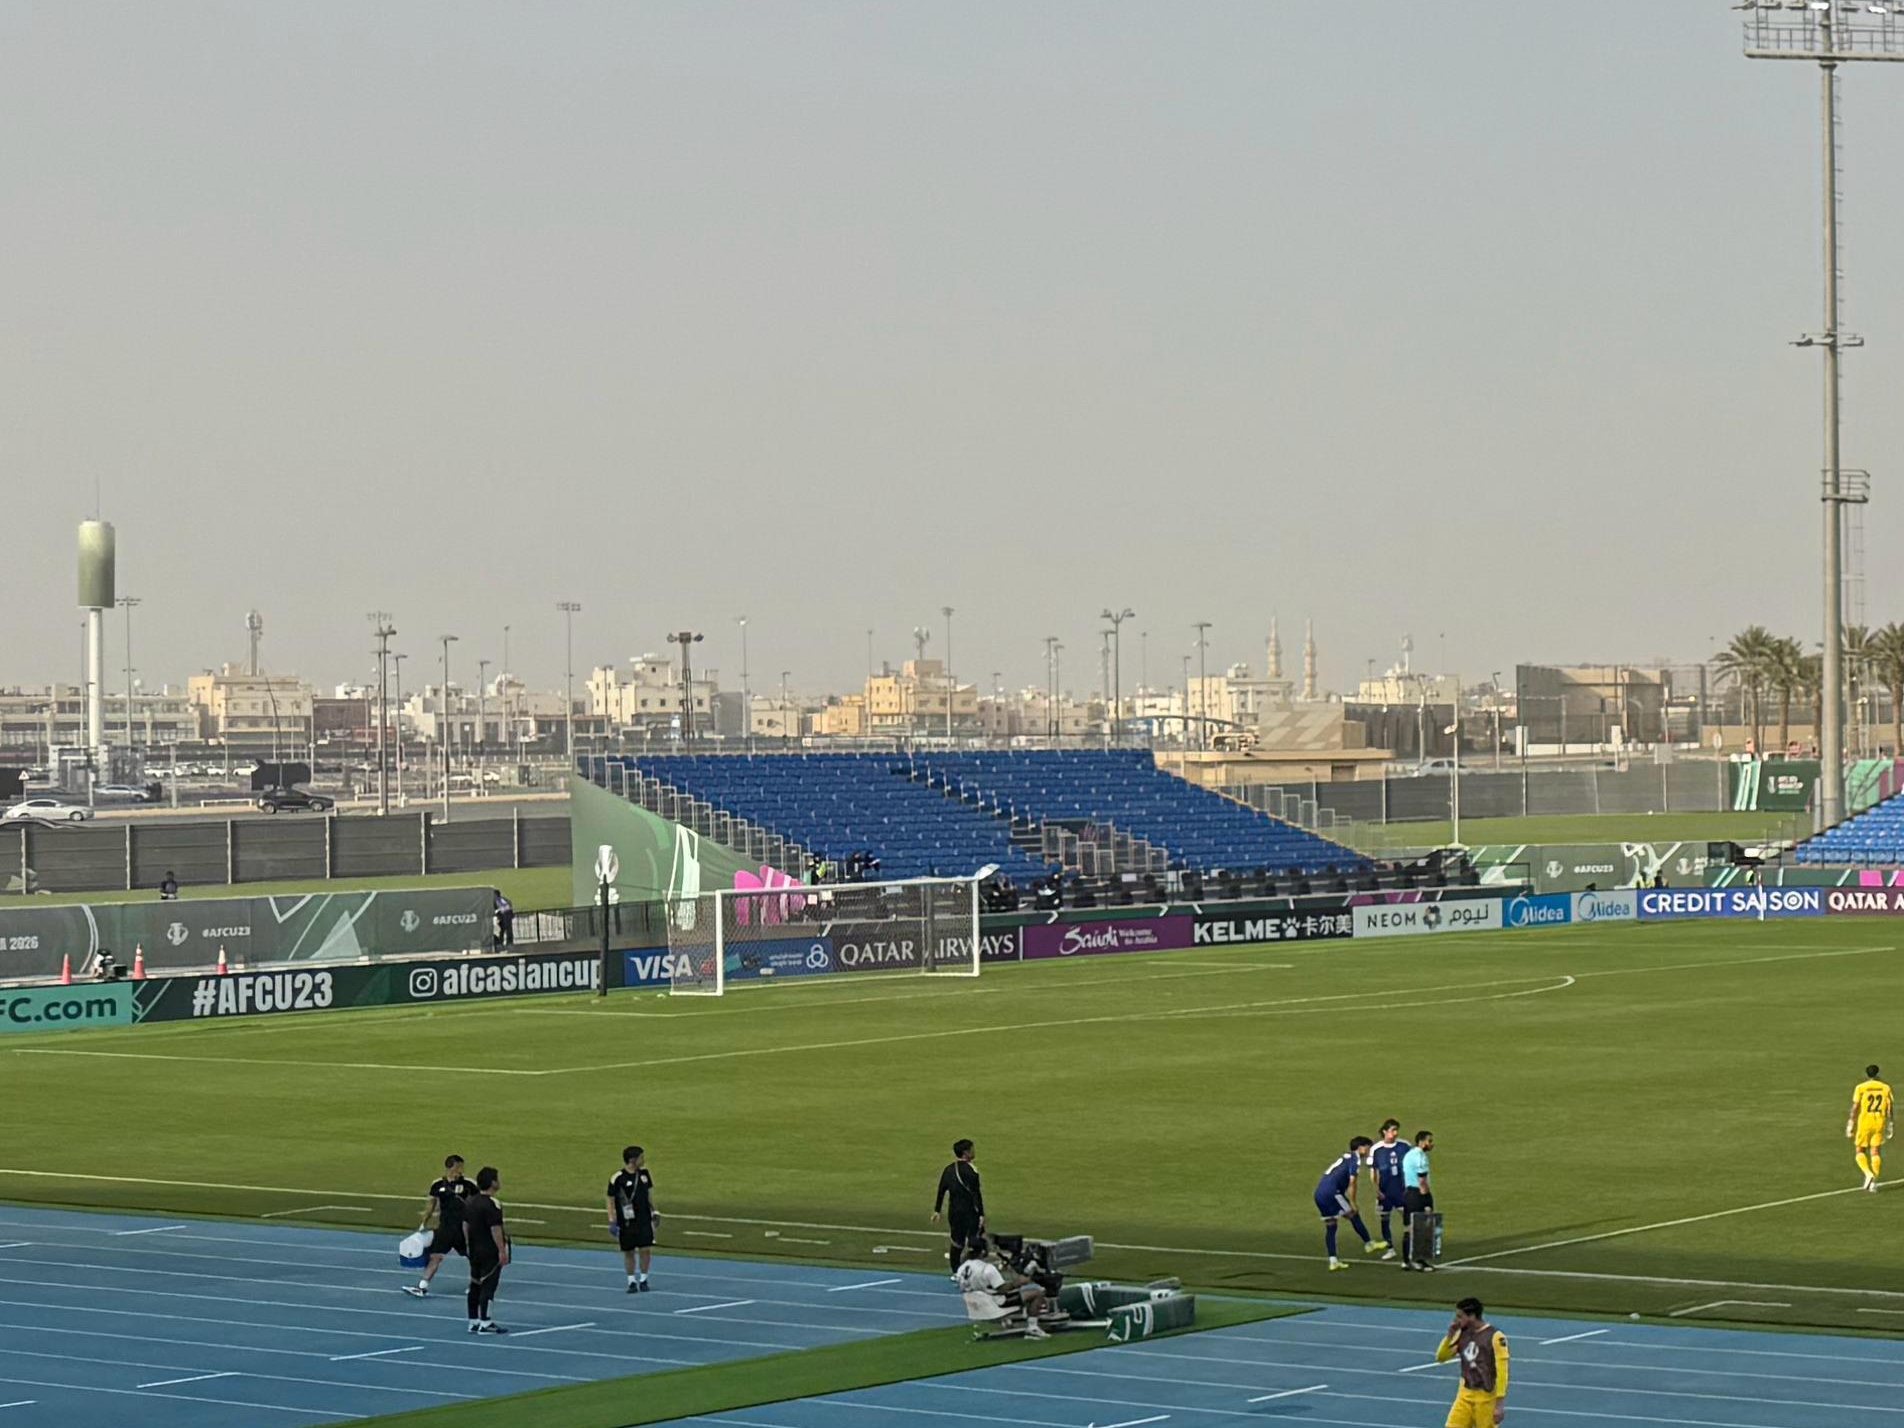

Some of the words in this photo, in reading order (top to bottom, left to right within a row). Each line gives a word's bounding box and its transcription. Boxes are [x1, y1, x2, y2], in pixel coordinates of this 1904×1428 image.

[1590, 900, 1630, 919] Midea
[1643, 892, 1726, 913] CREDIT
[1732, 891, 1819, 911] SAISON
[1829, 891, 1888, 910] QATAR
[1367, 913, 1417, 928] NEOM
[1521, 901, 1564, 922] Midea
[202, 925, 251, 938] #AFCU23
[1194, 919, 1280, 943] KELME
[1301, 913, 1354, 937] 卡尔美
[9, 936, 39, 950] 2026
[840, 939, 914, 965] QATAR
[630, 954, 694, 981] VISA
[192, 972, 333, 1017] #AFCU23
[1867, 1094, 1883, 1113] 22
